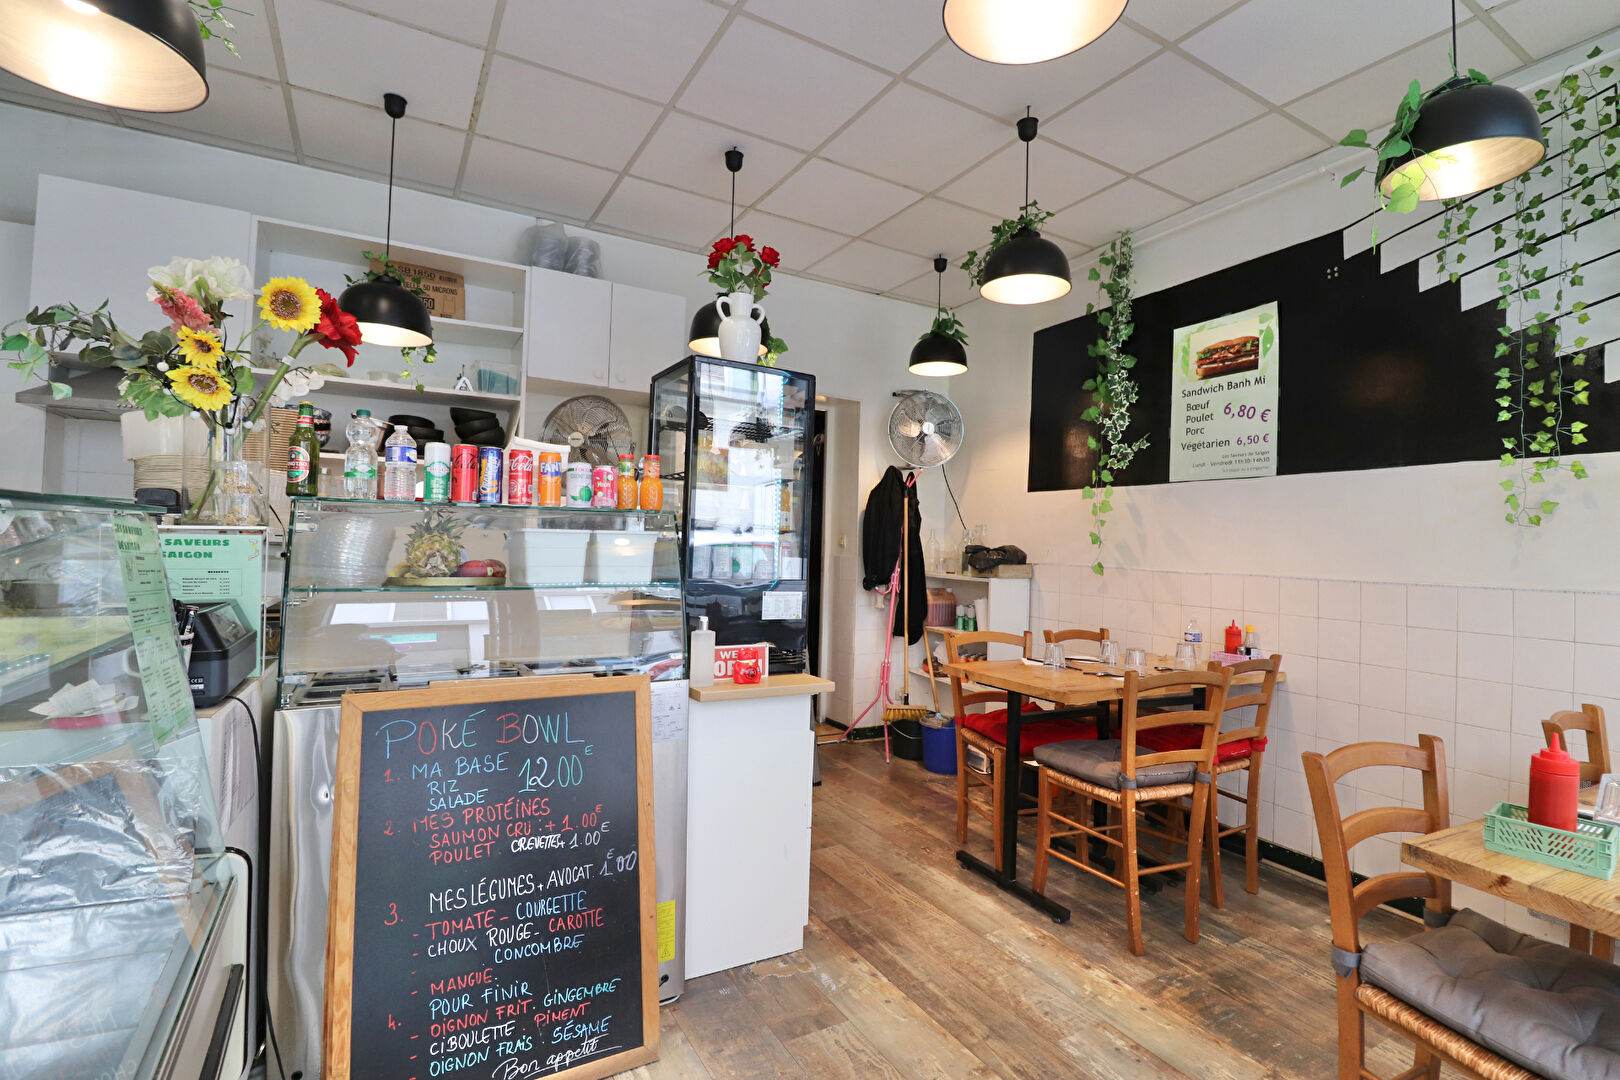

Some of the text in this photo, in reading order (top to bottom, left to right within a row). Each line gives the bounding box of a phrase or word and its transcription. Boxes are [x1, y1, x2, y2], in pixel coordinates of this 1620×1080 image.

[1181, 375, 1266, 399] Sandwich Banh Mi
[1185, 412, 1214, 424] Poulet
[1186, 400, 1210, 412] Bœuf
[1223, 402, 1271, 423] 6,80 €
[1181, 433, 1270, 452] Végétarien 6,50 €
[1185, 427, 1205, 436] Porc
[164, 538, 230, 546] SAVEURS
[376, 709, 585, 759] POKÉ BOWL
[412, 762, 442, 780] MA
[456, 751, 509, 776] BASE
[427, 779, 460, 796] RIZ
[427, 789, 489, 812] SALADE
[430, 825, 500, 850] SAUMON
[506, 821, 532, 838] CRU
[430, 887, 466, 913] MES
[471, 873, 534, 907] LÉGUMES
[424, 909, 497, 940] TOMATE
[515, 890, 588, 921] COURGETTE
[427, 936, 478, 959] CHOUX
[548, 907, 605, 934] CAROTTE
[494, 934, 586, 965] CONCOMBRE
[429, 993, 474, 1021] POUR
[551, 1015, 613, 1045] SÉSAME
[491, 1056, 541, 1080] Bon
